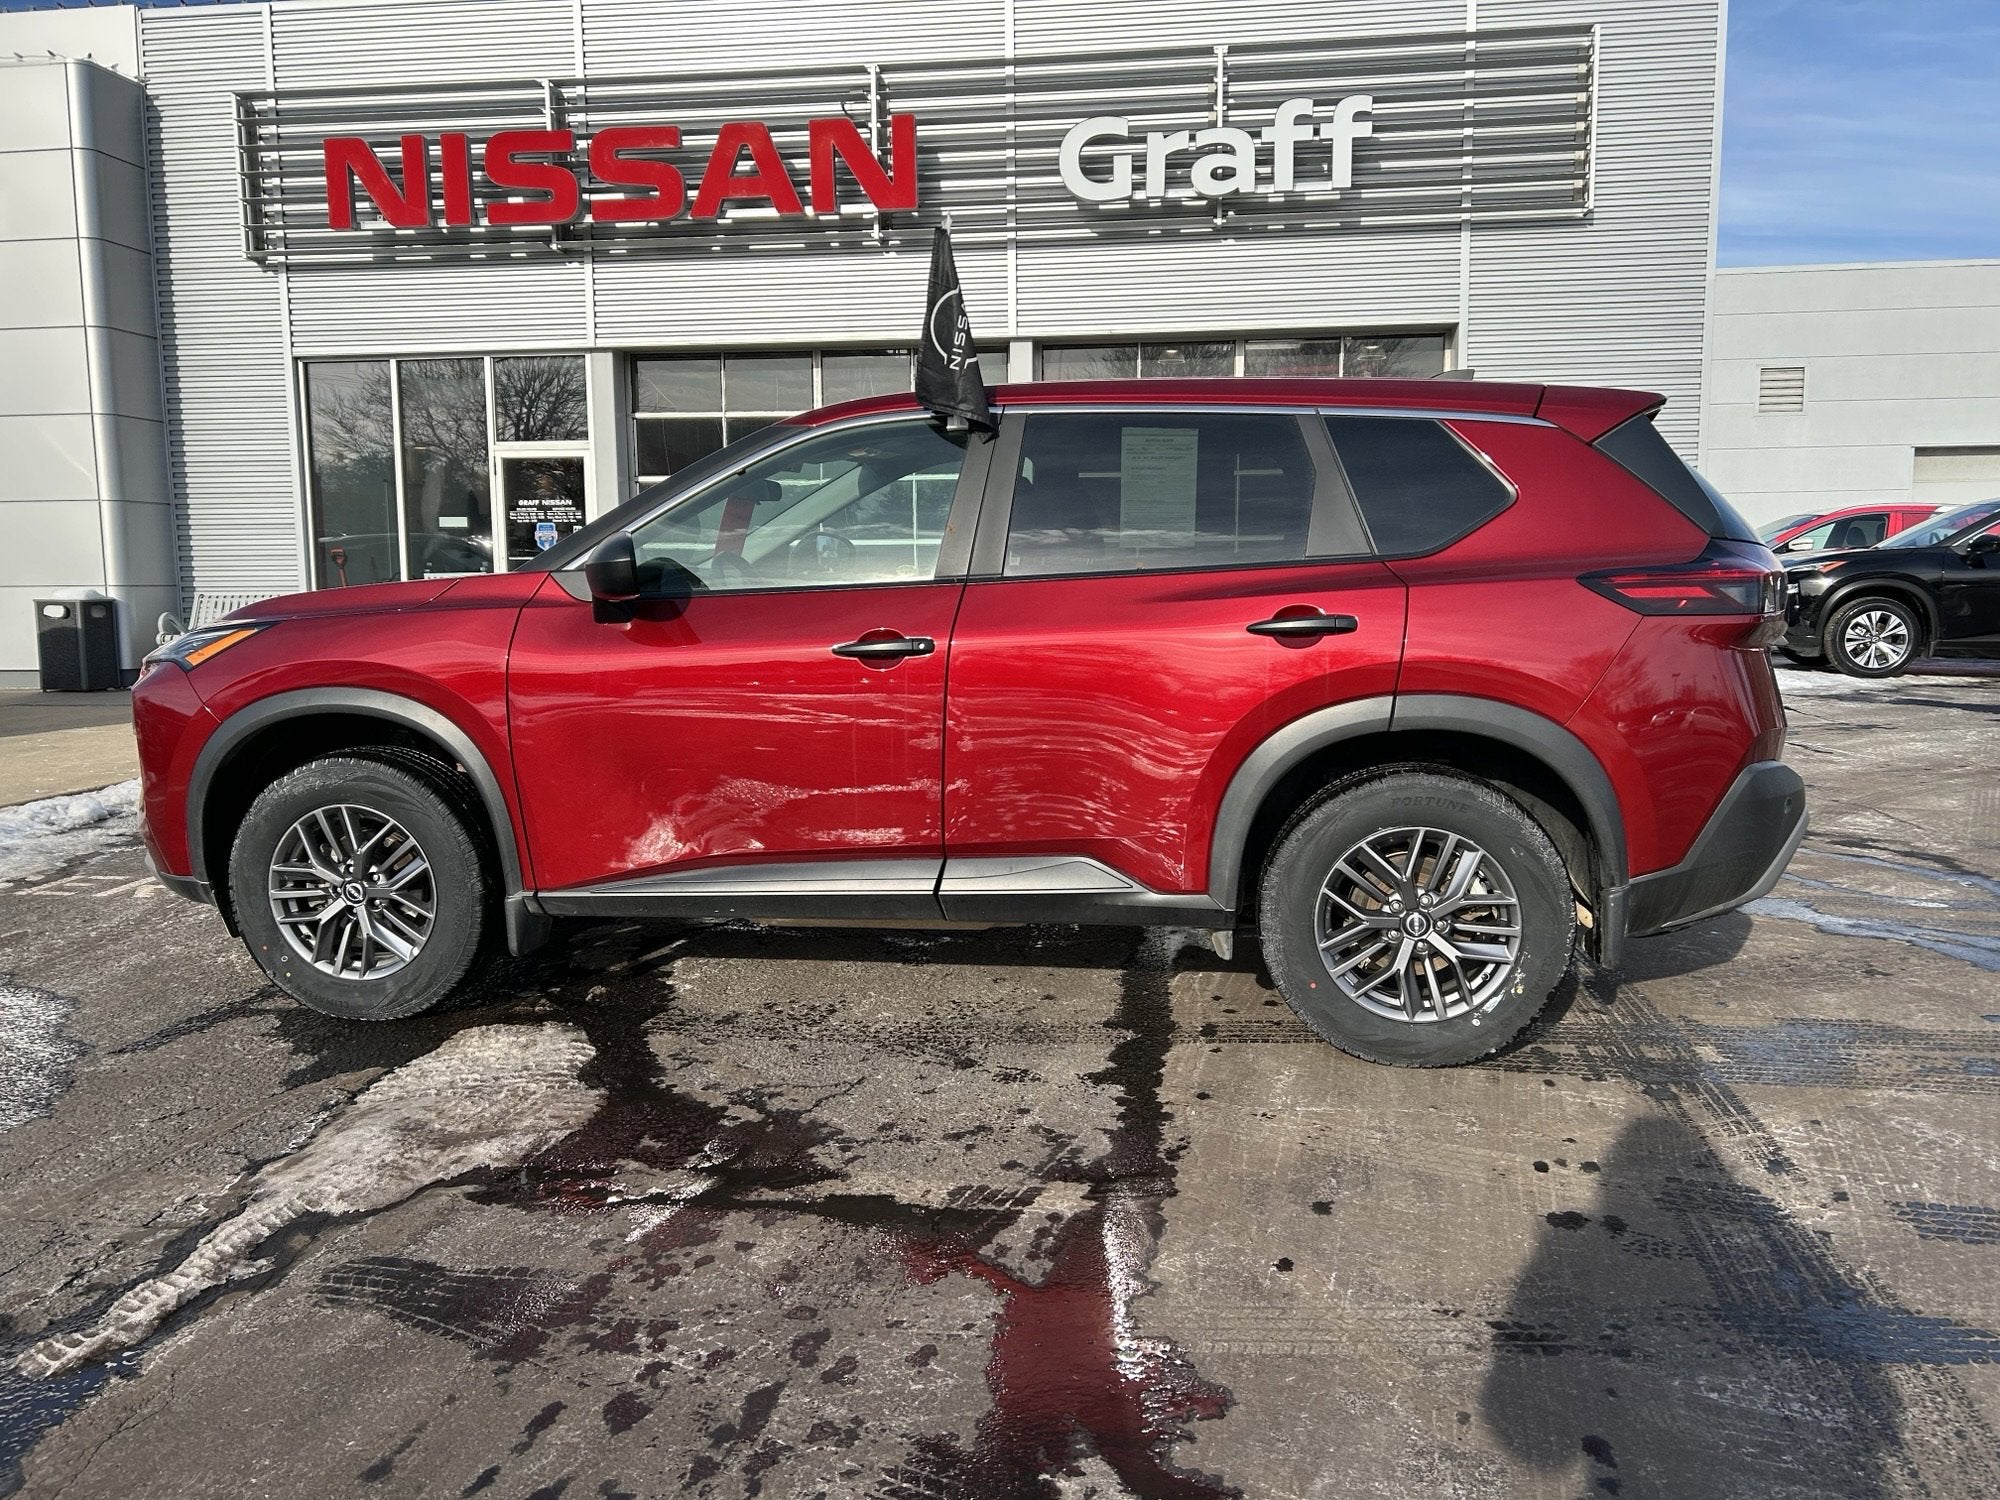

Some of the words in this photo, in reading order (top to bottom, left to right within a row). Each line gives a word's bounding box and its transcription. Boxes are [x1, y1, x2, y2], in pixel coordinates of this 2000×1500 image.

[323, 114, 918, 230] NISSAN
[1058, 95, 1373, 202] Graff
[1391, 796, 1472, 813] FORTUNE
